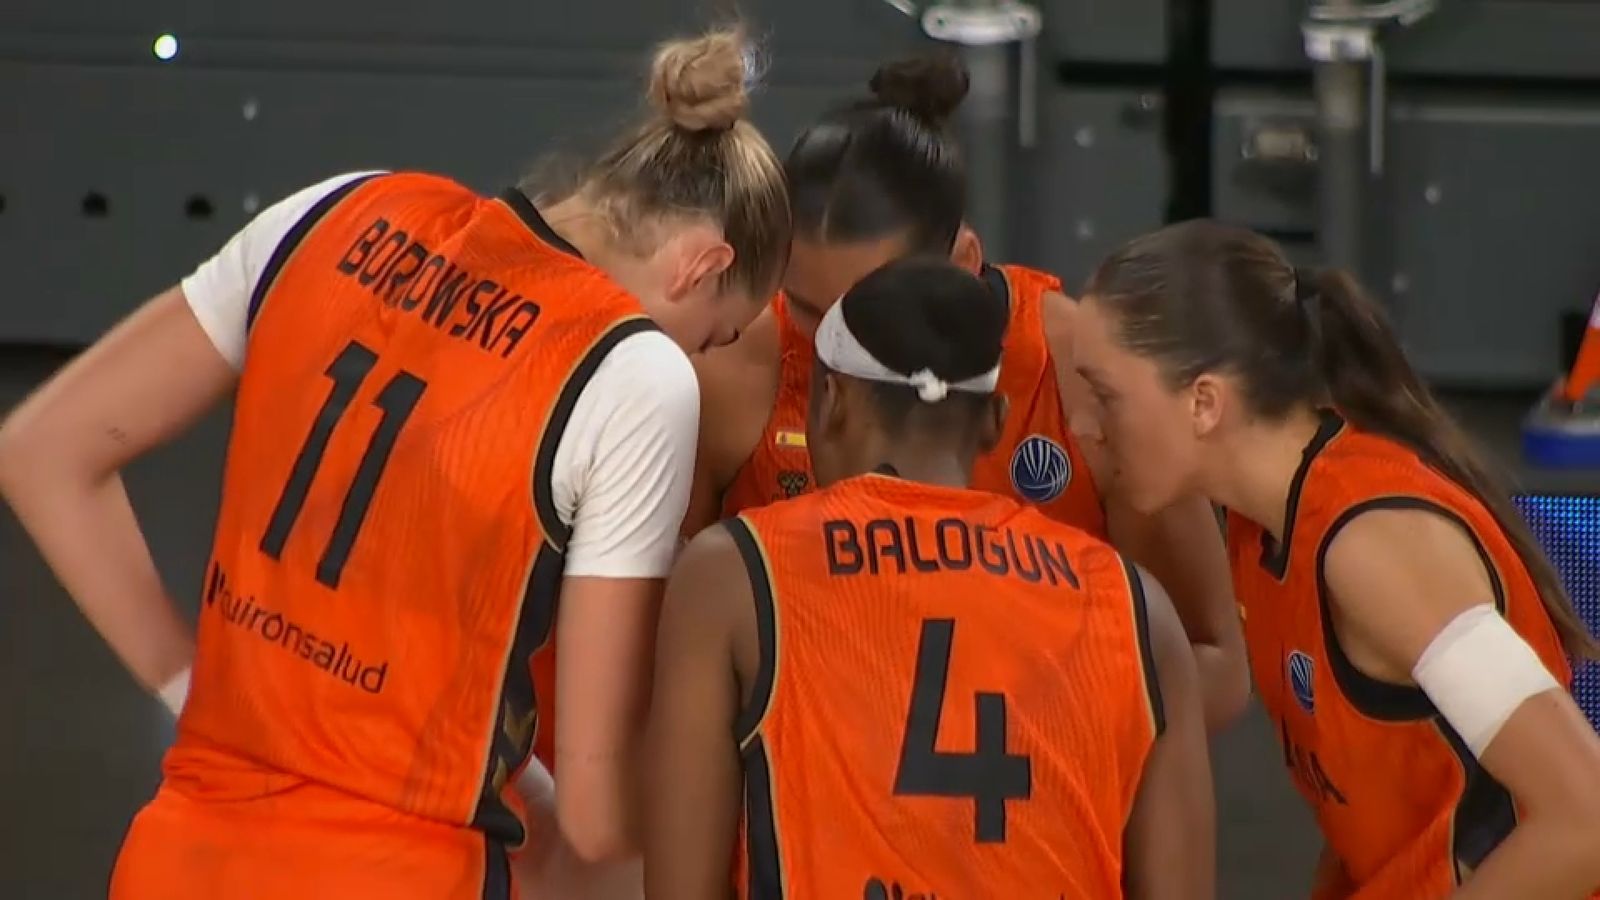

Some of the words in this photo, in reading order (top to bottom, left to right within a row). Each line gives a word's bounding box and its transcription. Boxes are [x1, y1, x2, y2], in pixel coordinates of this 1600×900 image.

[337, 217, 540, 358] BOROWSKA
[260, 340, 427, 590] 11
[824, 517, 1080, 590] BALOGUN
[892, 618, 1031, 843] 4
